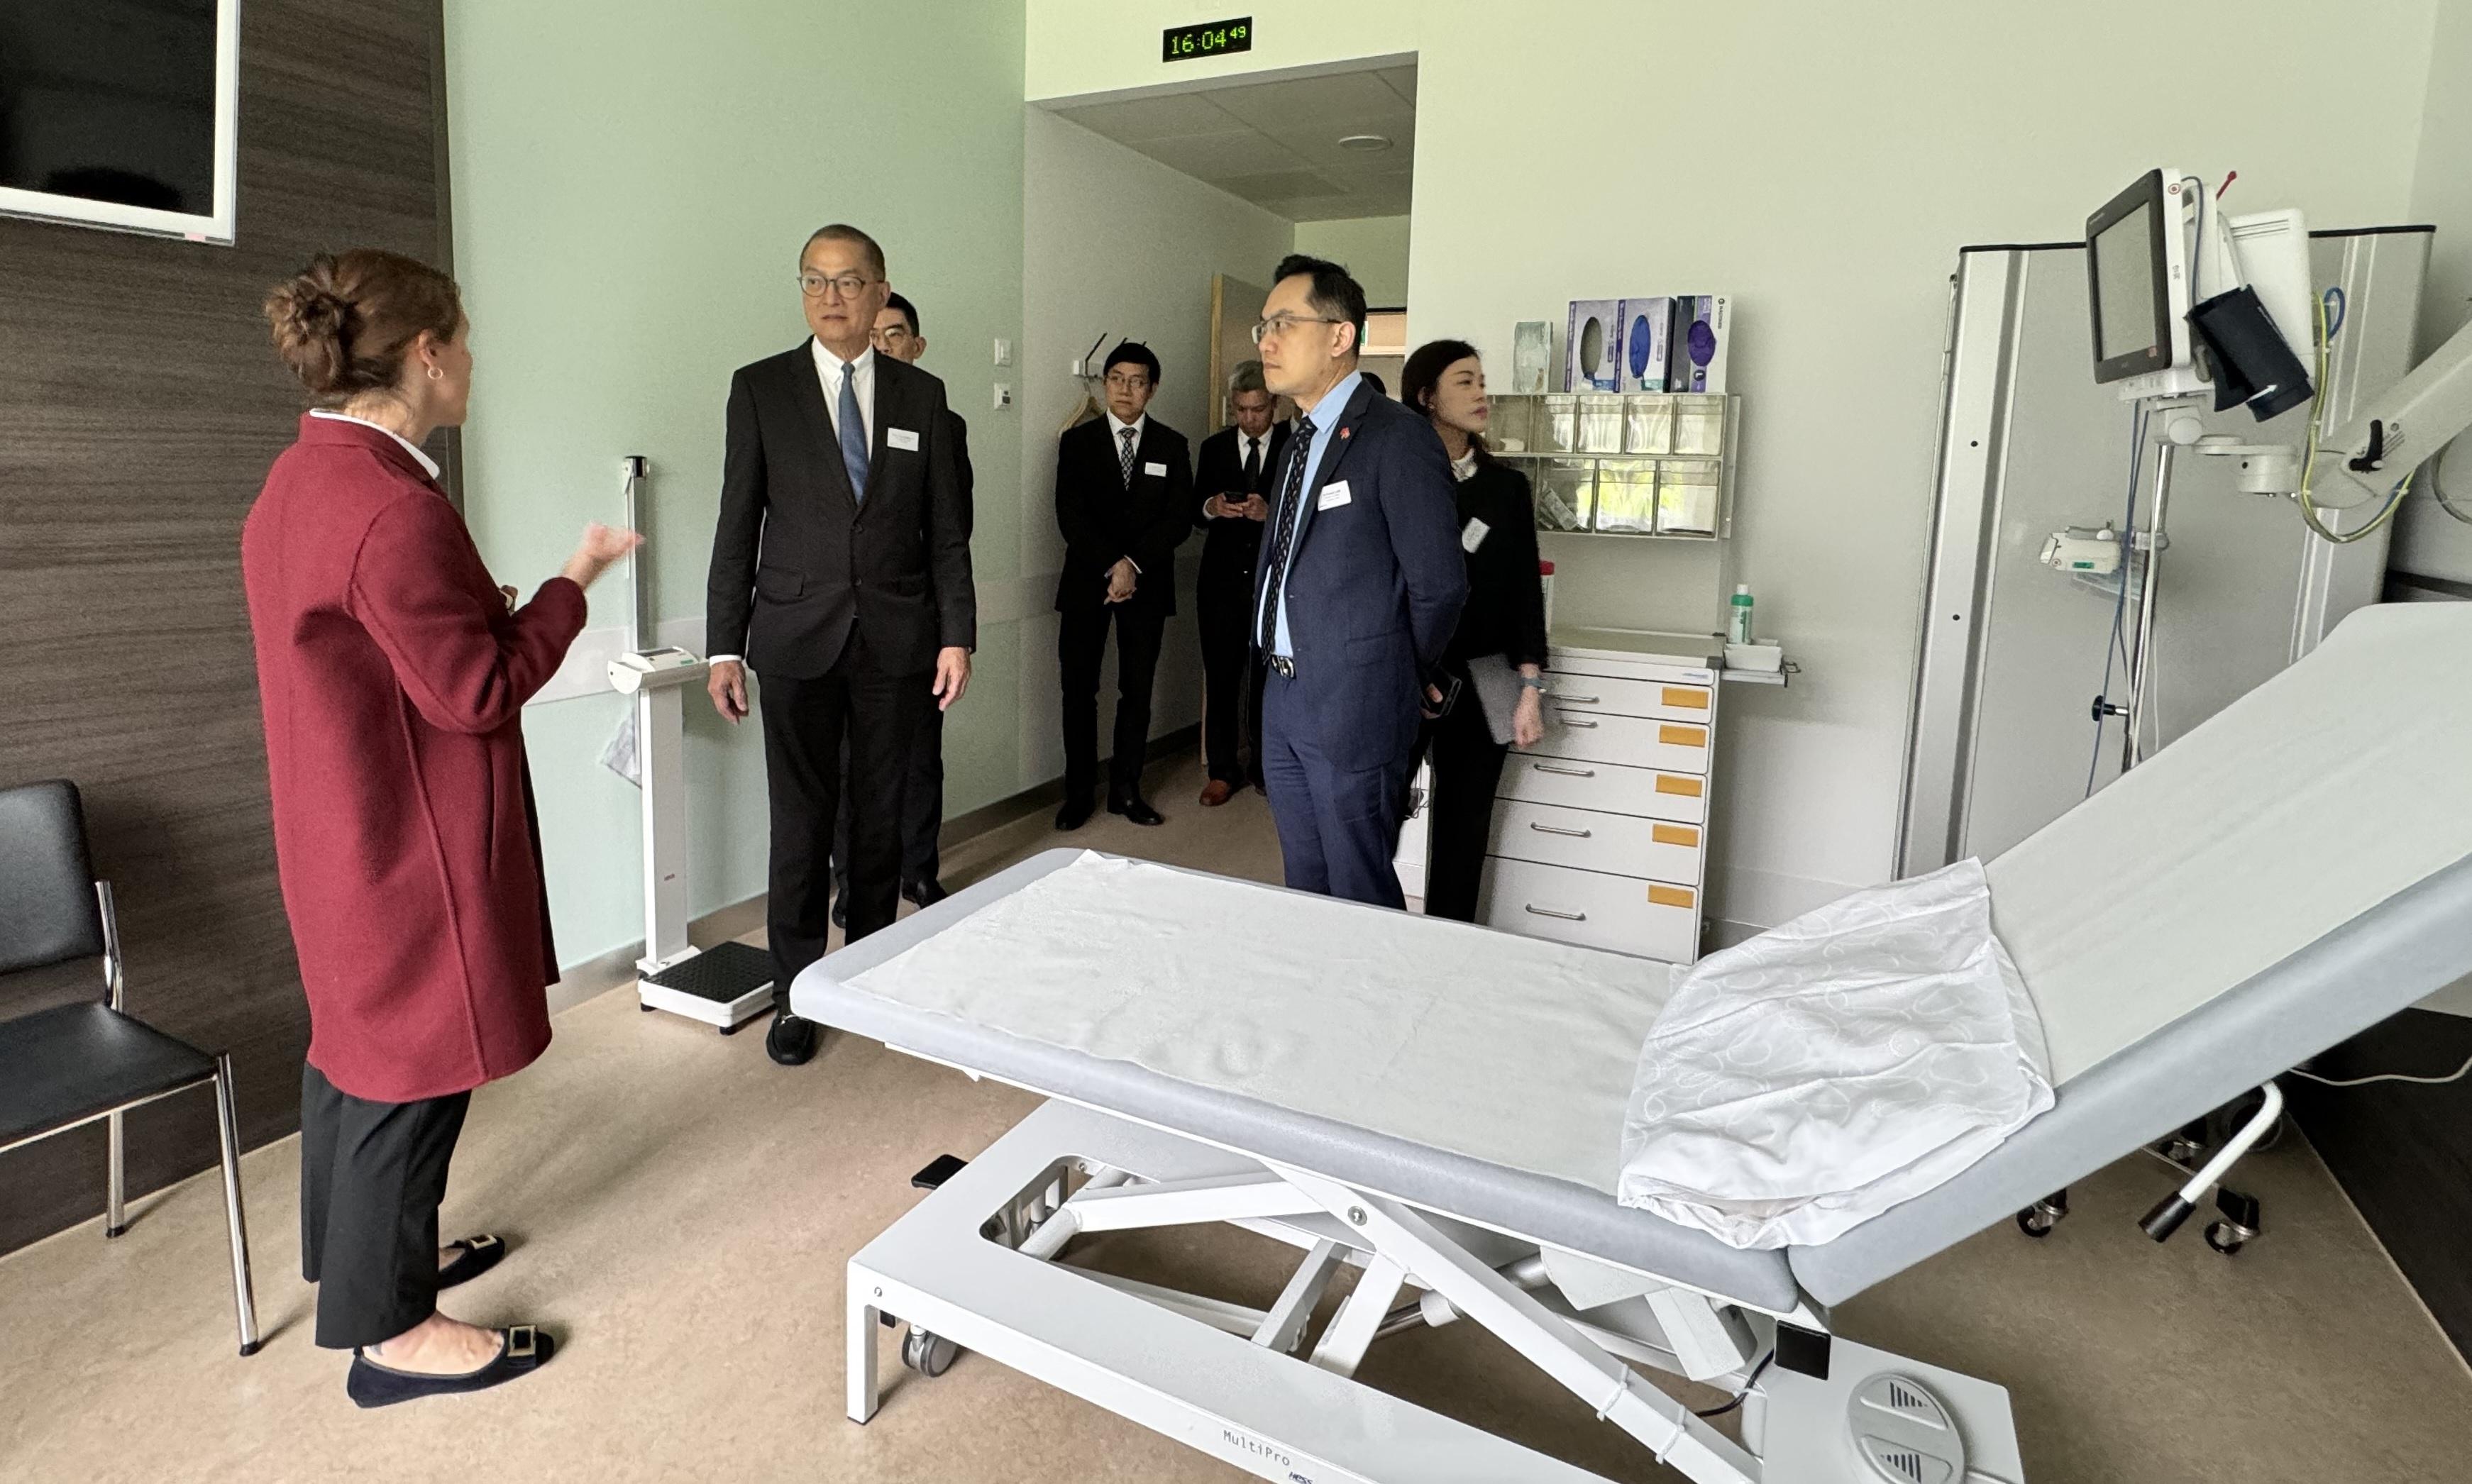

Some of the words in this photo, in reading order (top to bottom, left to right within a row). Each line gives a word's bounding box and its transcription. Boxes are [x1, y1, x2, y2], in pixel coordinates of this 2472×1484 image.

[1171, 29, 1226, 54] 16:04
[1230, 26, 1247, 39] 49
[1223, 1429, 1291, 1466] MultiPro
